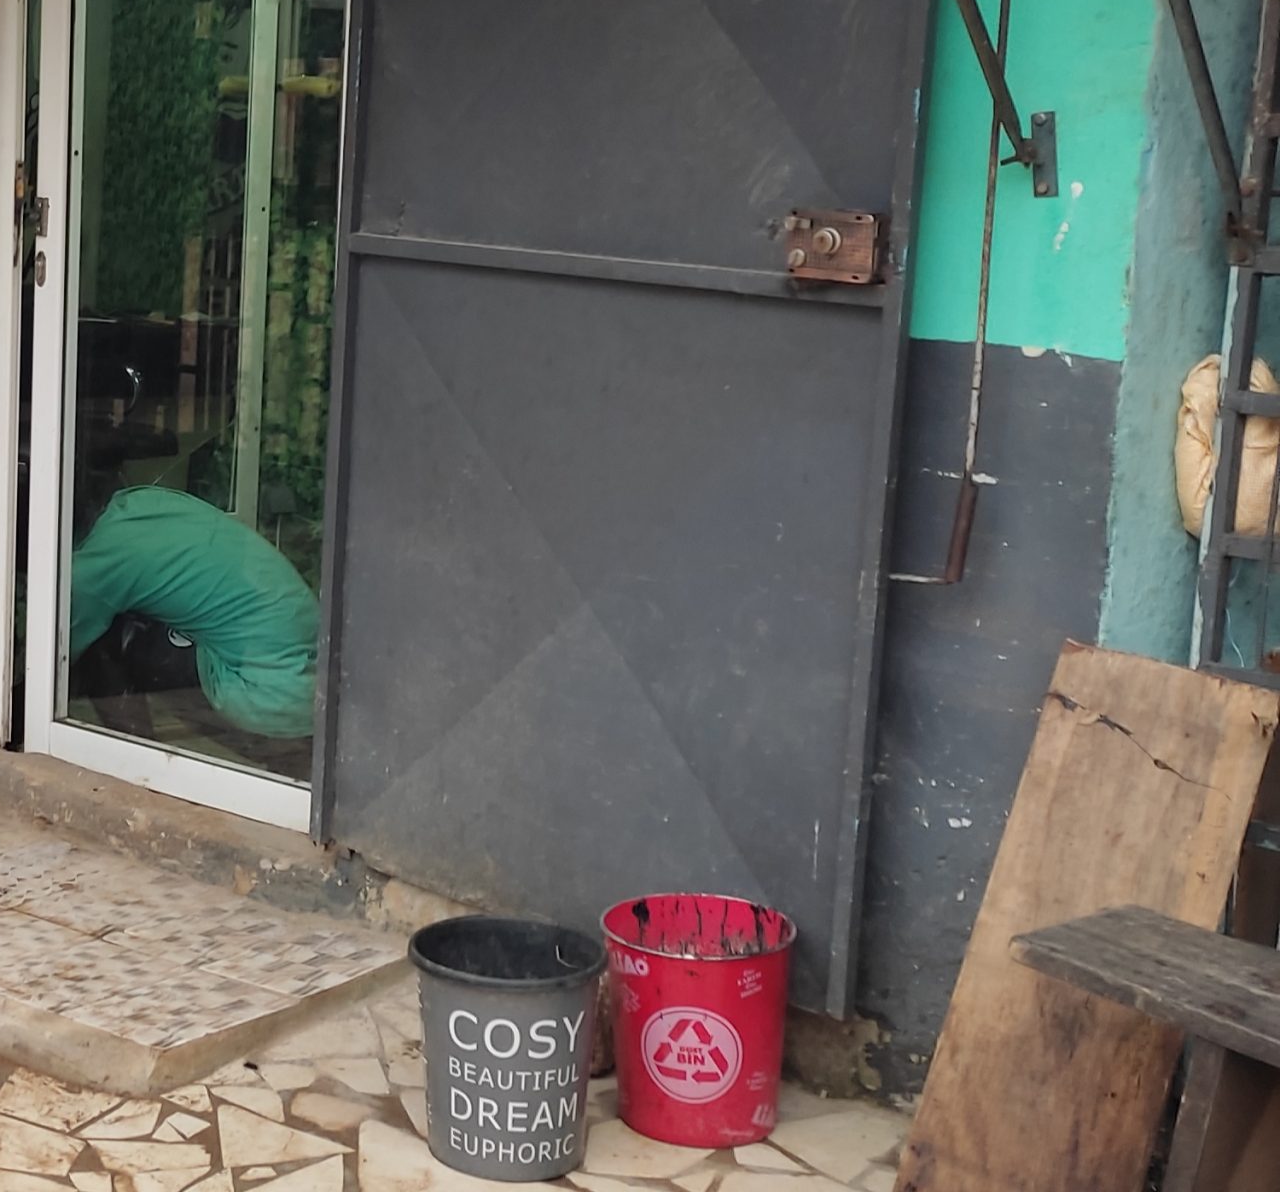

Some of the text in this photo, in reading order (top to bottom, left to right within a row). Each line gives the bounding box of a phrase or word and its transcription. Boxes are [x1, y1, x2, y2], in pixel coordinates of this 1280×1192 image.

[447, 1009, 586, 1059] COSY
[448, 1055, 580, 1092] BEAUTIFUL
[677, 1053, 705, 1066] BIN
[450, 1086, 578, 1133] DREAM
[450, 1126, 575, 1164] EUPHORIC
